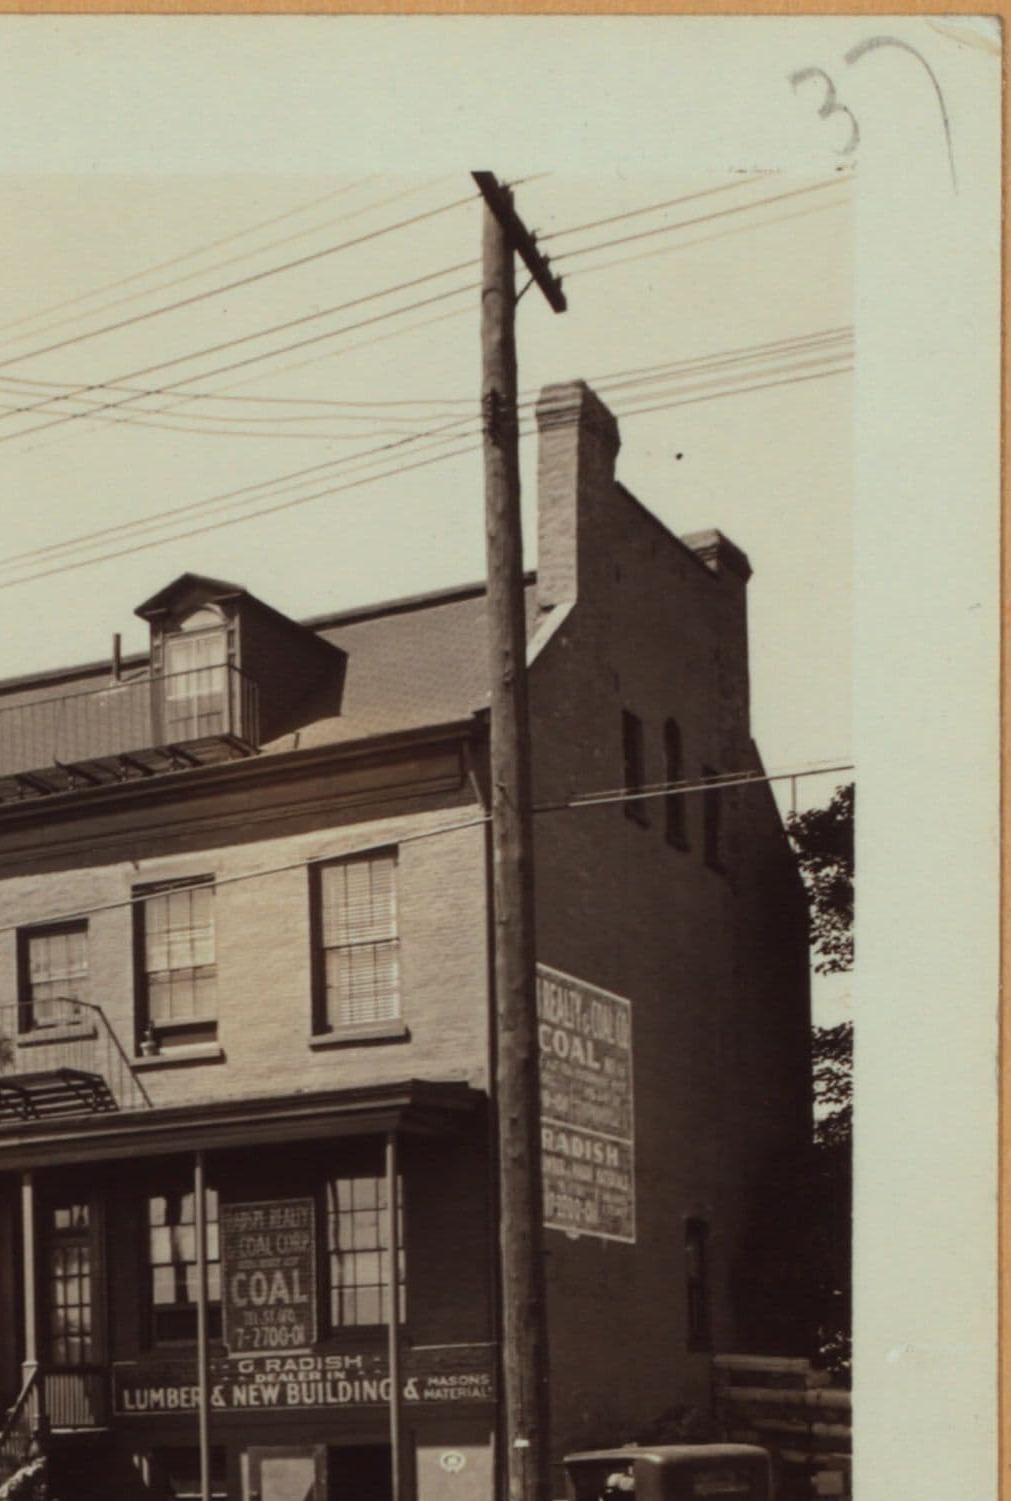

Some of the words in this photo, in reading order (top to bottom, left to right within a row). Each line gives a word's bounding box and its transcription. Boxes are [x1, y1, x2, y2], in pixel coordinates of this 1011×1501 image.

[538, 1023, 601, 1069] COAL
[541, 1128, 618, 1167] RADISH
[230, 1269, 308, 1307] COAL
[254, 1371, 321, 1383] DEALER
[326, 1370, 346, 1380] IN
[265, 1355, 362, 1372] RADISH
[123, 1386, 201, 1410] LUMBER
[209, 1385, 225, 1406] &
[232, 1383, 279, 1406] NEW
[403, 1377, 420, 1400] &
